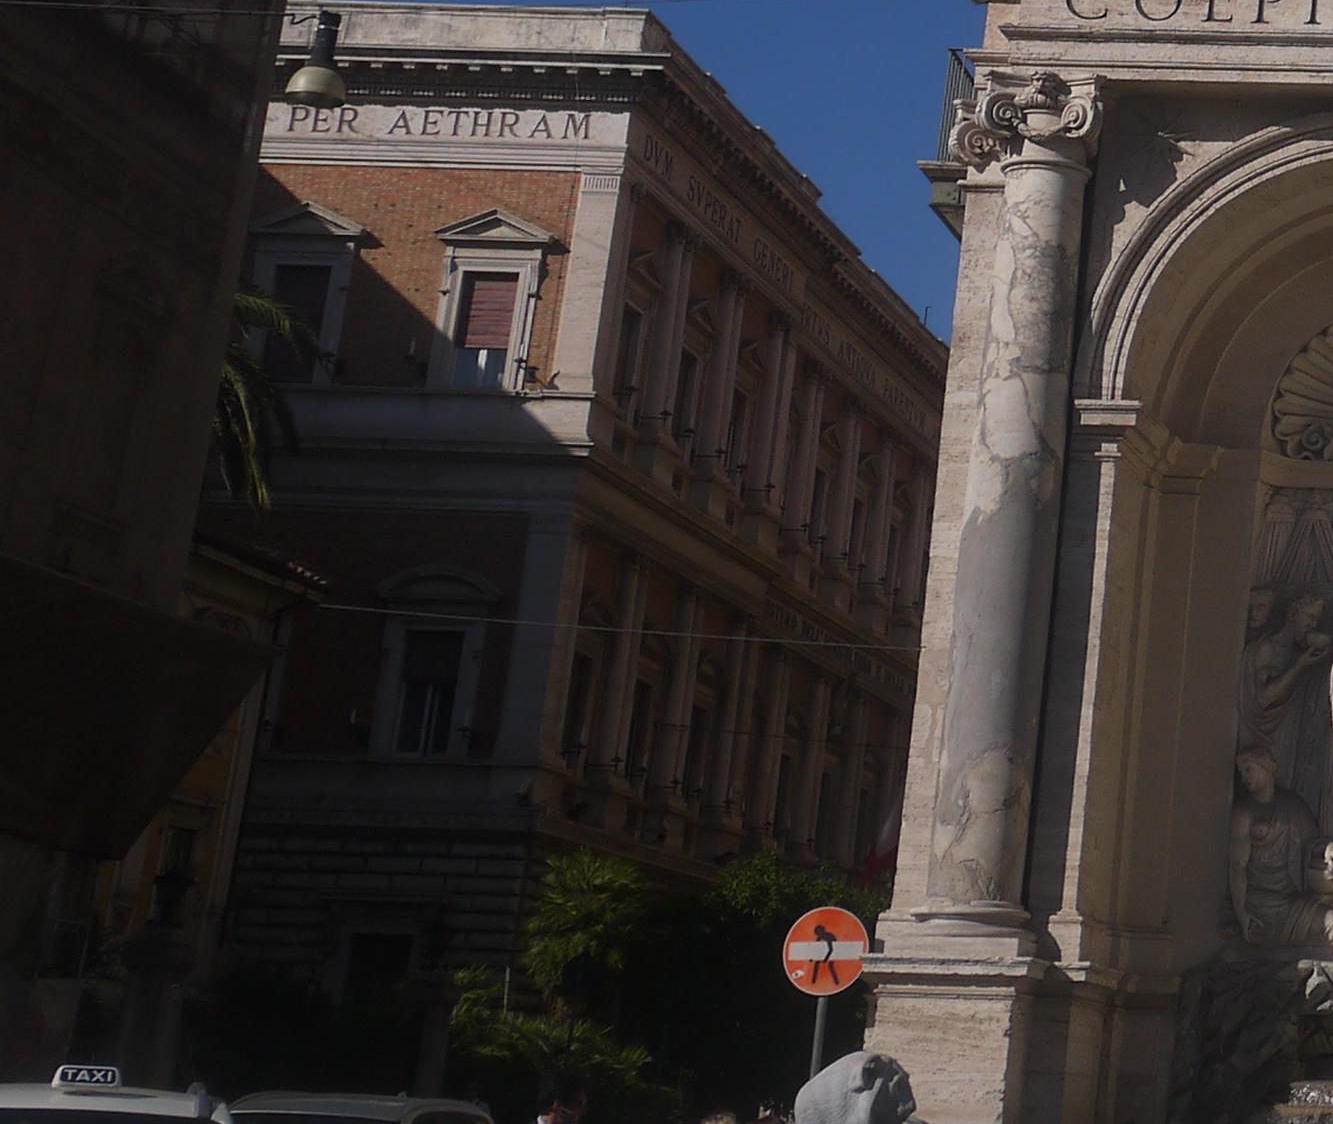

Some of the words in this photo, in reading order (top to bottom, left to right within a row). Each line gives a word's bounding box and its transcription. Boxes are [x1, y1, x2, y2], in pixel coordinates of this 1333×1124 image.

[286, 106, 359, 134] PER
[387, 109, 592, 140] AETHRAM
[63, 1068, 113, 1083] TAXI
